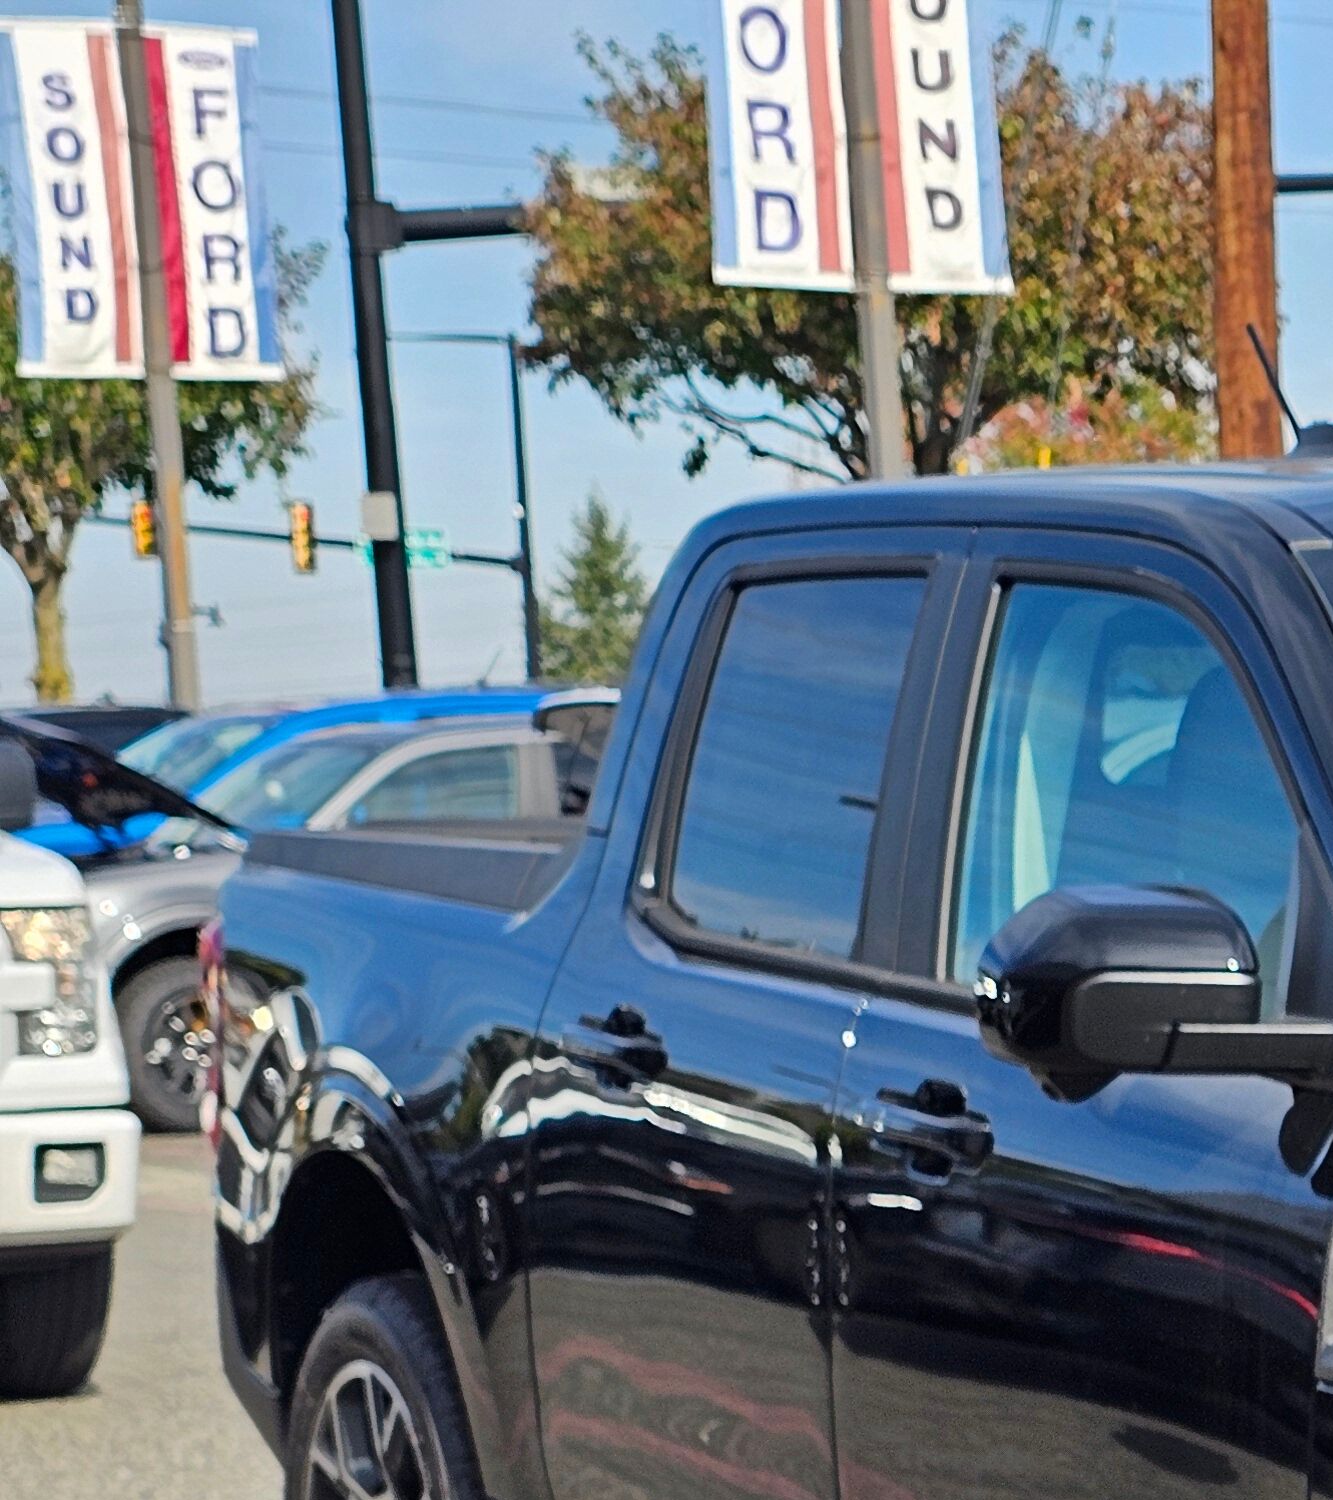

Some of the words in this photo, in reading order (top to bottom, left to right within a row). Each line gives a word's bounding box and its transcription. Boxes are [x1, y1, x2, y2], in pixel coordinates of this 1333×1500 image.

[42, 73, 99, 324] SOUND
[190, 87, 246, 359] FORD
[739, 6, 802, 252] ORD
